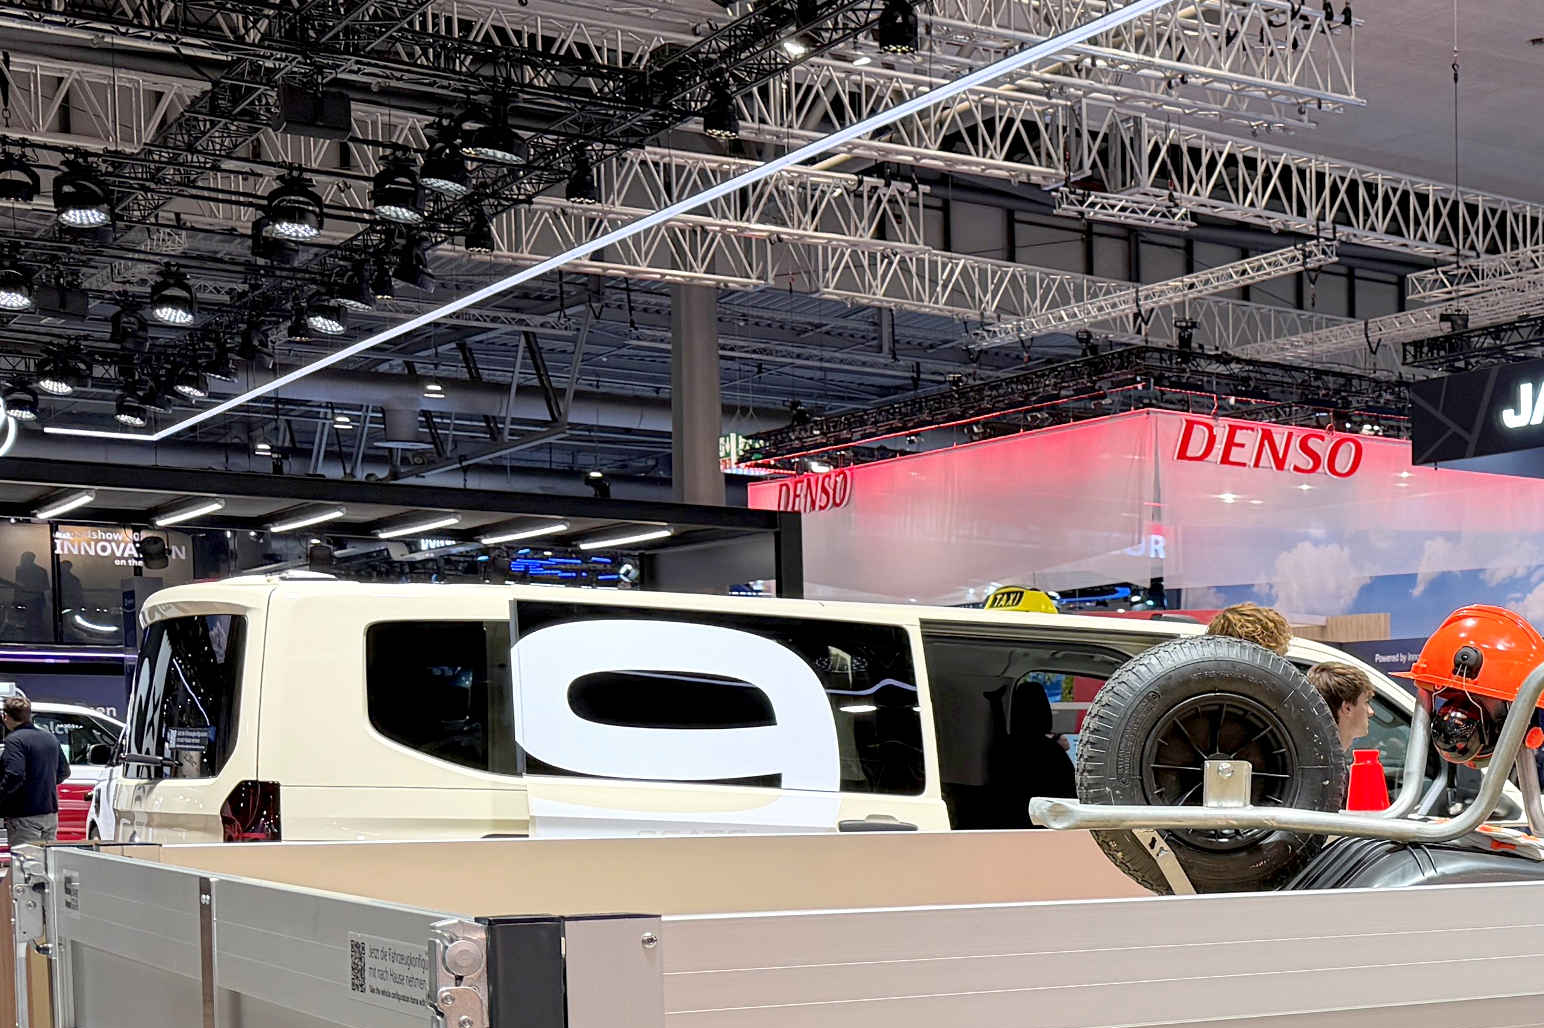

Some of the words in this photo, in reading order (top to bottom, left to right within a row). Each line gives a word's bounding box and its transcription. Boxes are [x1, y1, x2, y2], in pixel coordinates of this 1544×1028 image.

[1174, 418, 1364, 478] DENSO
[777, 470, 850, 513] DENSO
[54, 538, 187, 560] INNOVAN
[114, 559, 127, 567] on
[993, 592, 1022, 608] TAXI
[1375, 653, 1400, 663] Powered
[1400, 654, 1408, 665] by
[1408, 652, 1421, 662] Inn
